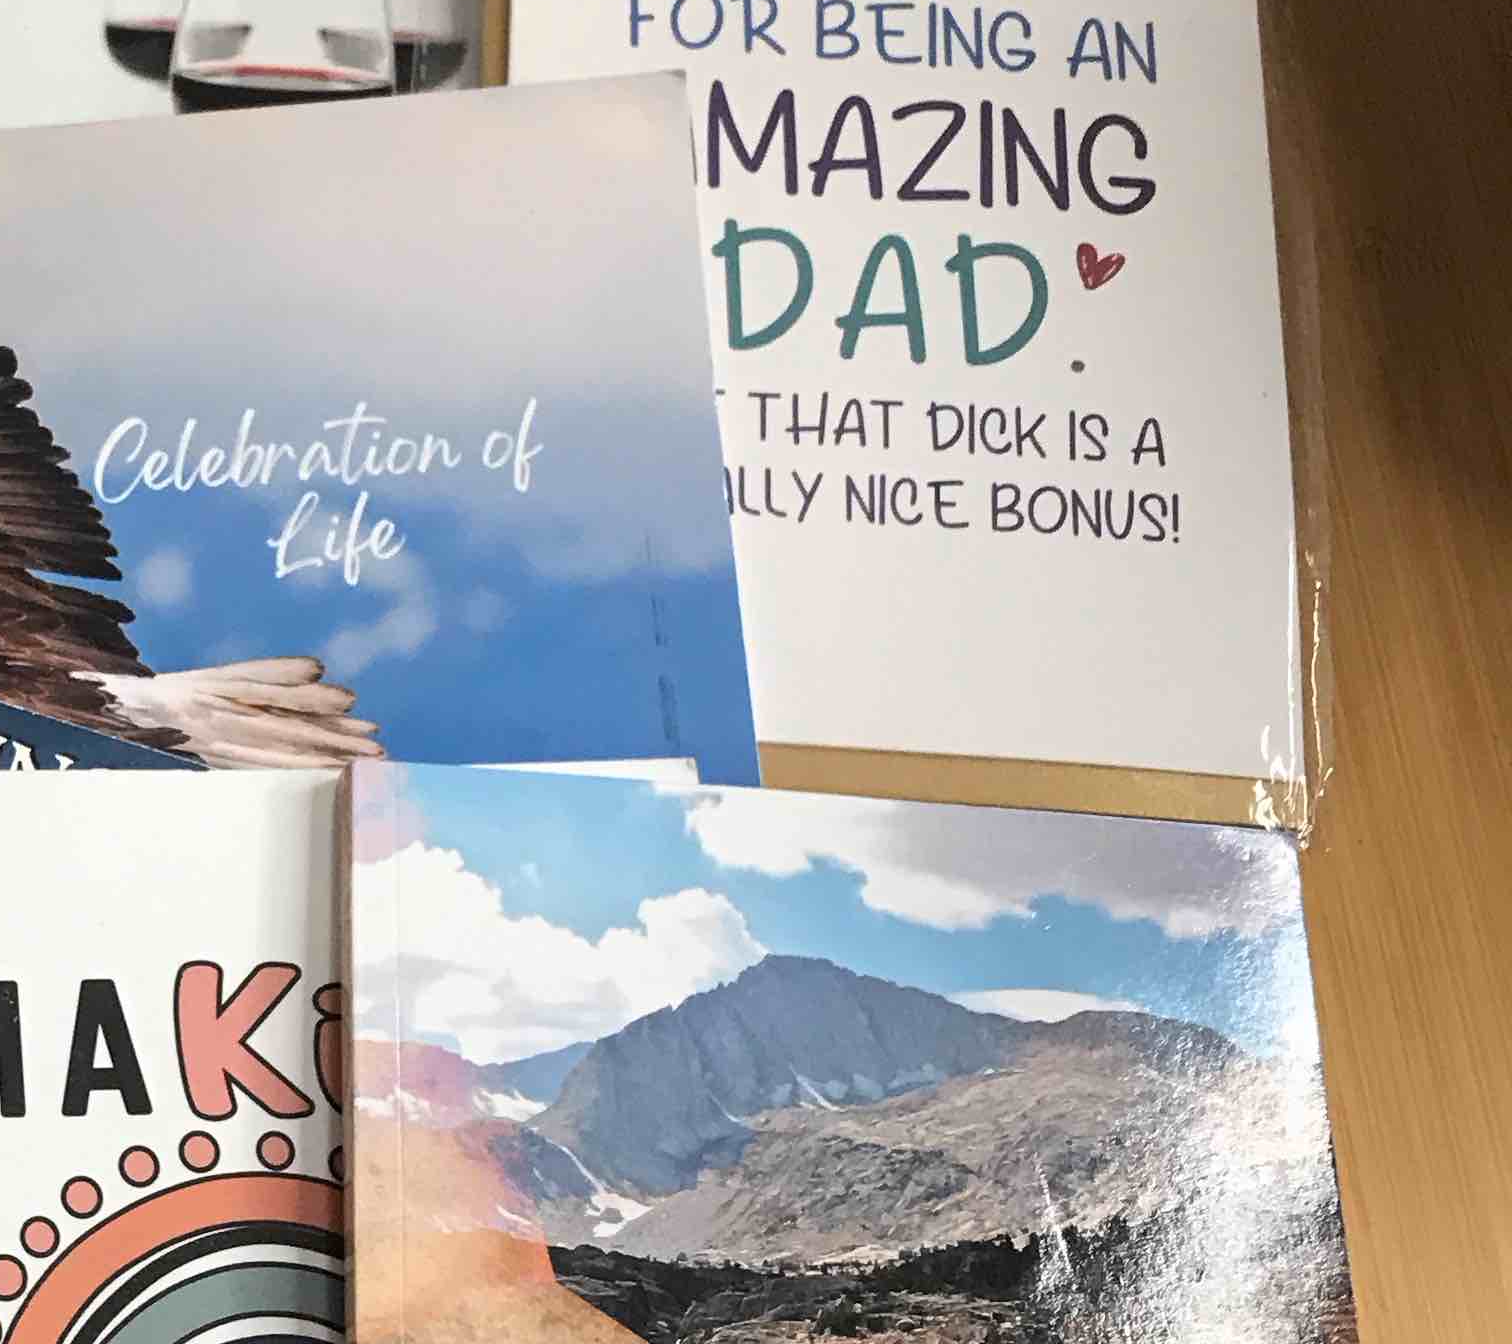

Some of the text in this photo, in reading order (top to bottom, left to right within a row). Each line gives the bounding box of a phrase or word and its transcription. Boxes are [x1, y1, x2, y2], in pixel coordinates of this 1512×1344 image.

[1067, 16, 1157, 84] AN
[691, 79, 1156, 216] MAZING
[94, 397, 544, 504] Celebration of
[748, 392, 1166, 467] THAT DICK IS A
[267, 490, 406, 586] Life
[845, 473, 969, 530] NICE
[991, 482, 1182, 545] BONUS!
[61, 978, 153, 1116] A
